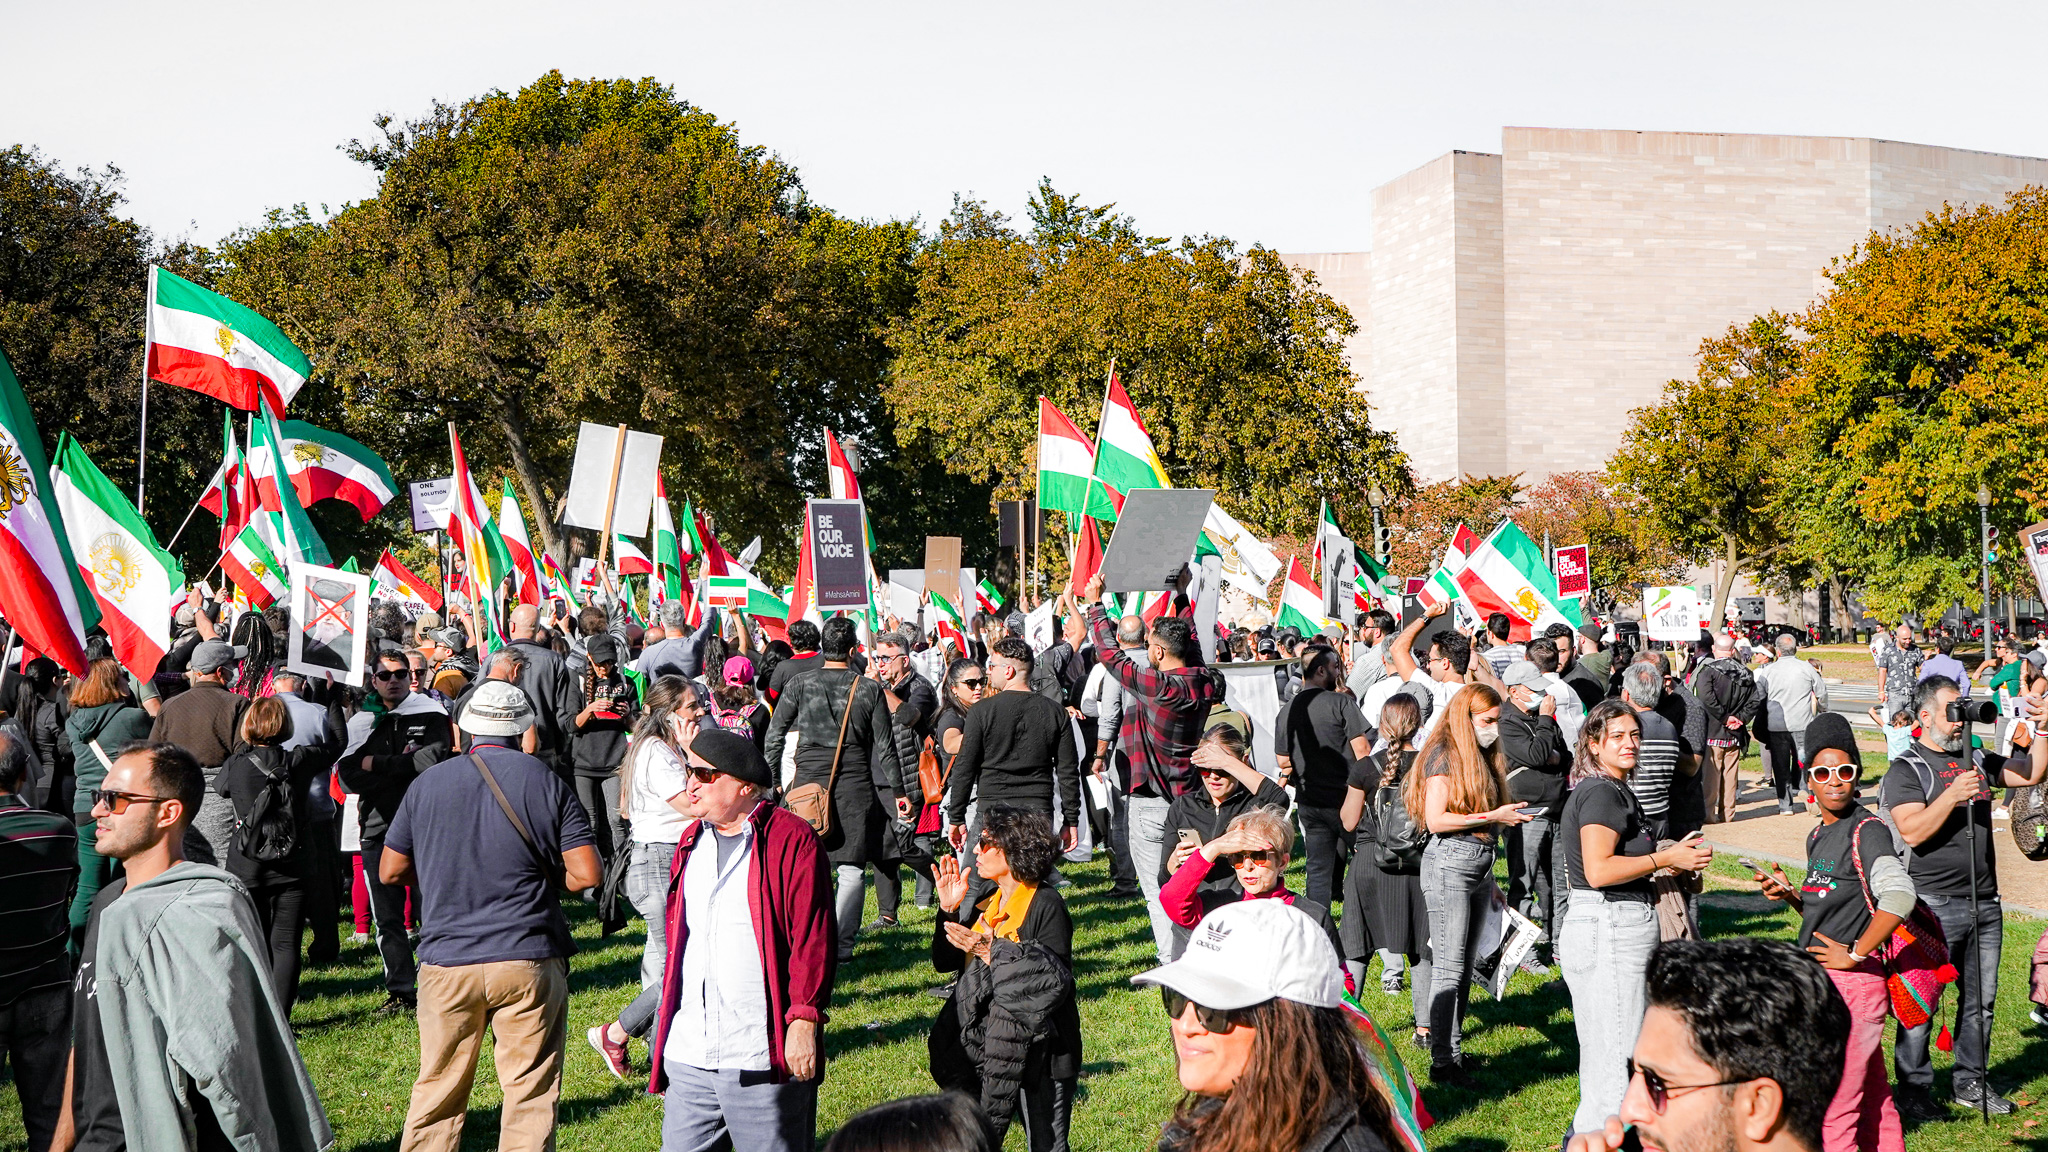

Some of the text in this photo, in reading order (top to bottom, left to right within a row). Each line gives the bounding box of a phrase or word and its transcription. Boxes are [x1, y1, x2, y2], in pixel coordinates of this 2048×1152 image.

[420, 482, 434, 490] ONE
[420, 489, 447, 498] SOLUTION
[818, 515, 833, 528] BE
[818, 529, 843, 543] OUR
[820, 544, 854, 558] VOICE
[1559, 555, 1570, 564] BE
[1559, 561, 1576, 571] OUR
[1560, 567, 1584, 577] VOICE
[1340, 580, 1353, 590] FREE
[825, 590, 860, 599] #MahsaAmini
[1196, 939, 1221, 952] adidas
[1513, 929, 1537, 958] Women
